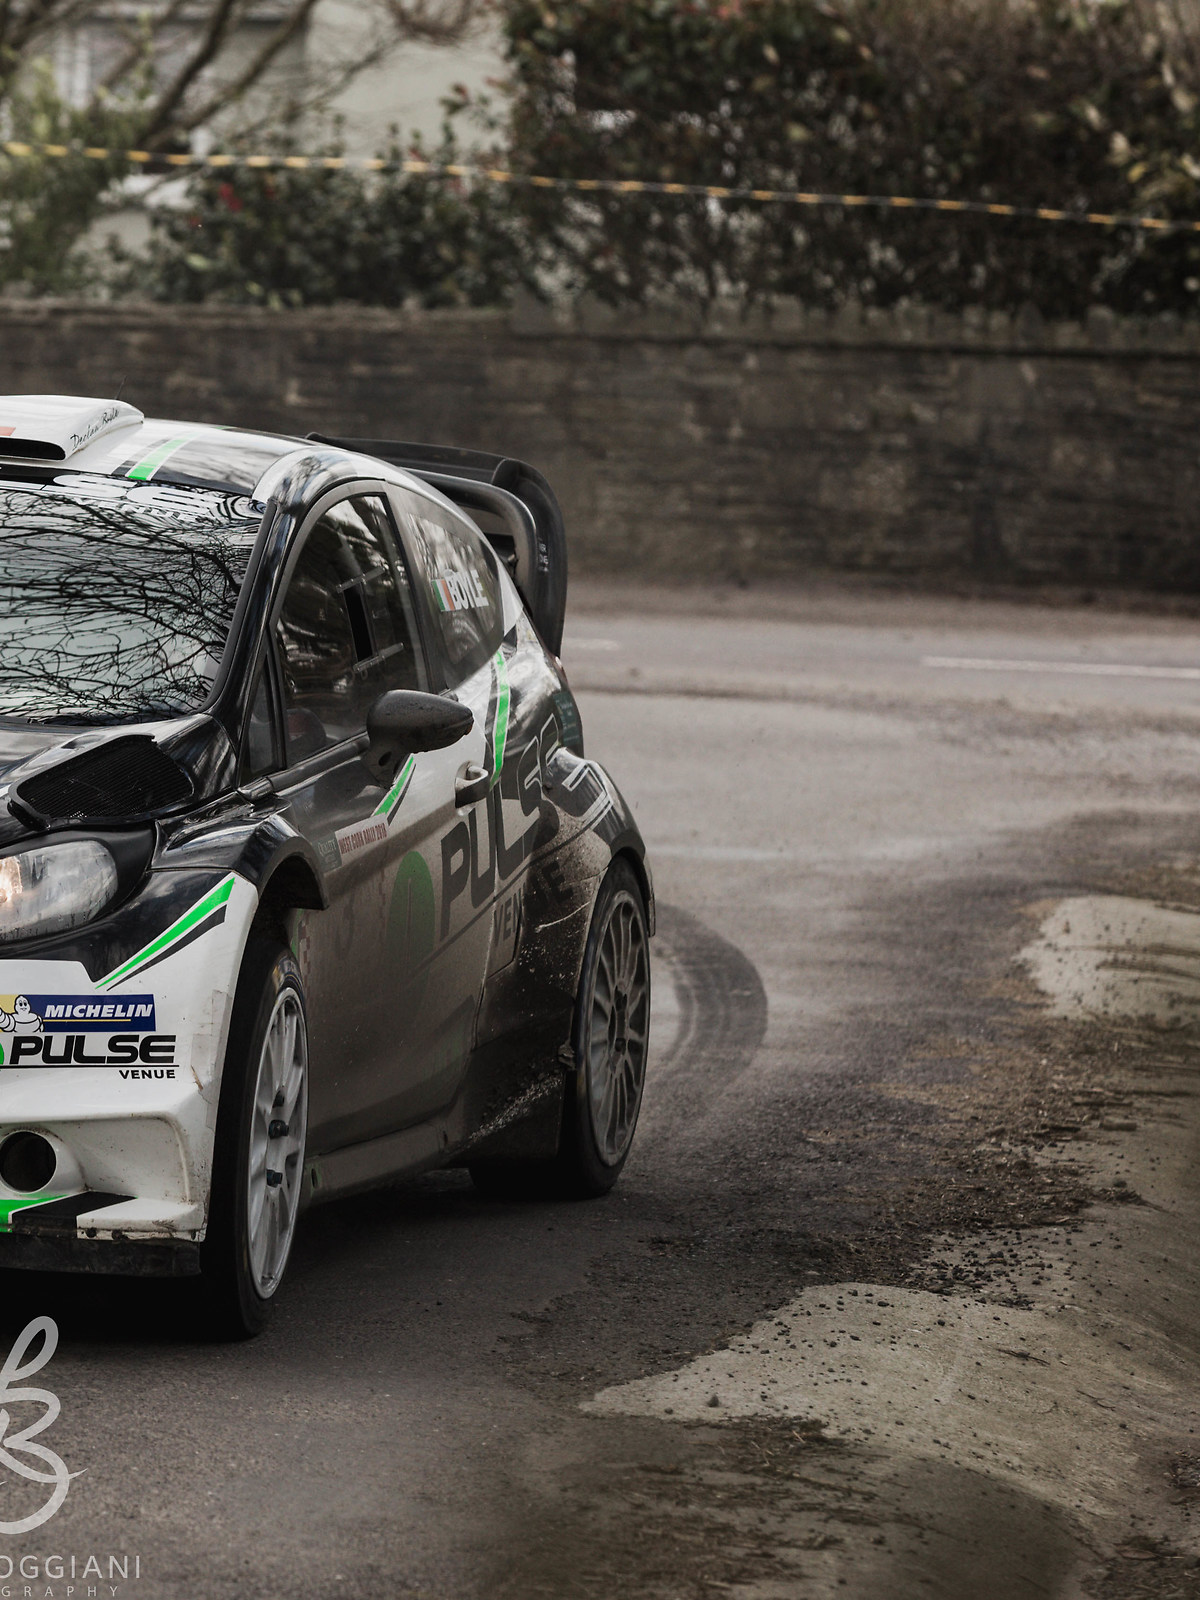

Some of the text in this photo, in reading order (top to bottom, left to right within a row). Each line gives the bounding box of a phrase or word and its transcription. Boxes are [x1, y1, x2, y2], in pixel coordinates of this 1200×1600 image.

[444, 569, 490, 610] BOYLE
[338, 835, 353, 855] WEST
[350, 831, 365, 850] CORK
[45, 1003, 154, 1018] MICHELIN
[9, 1034, 177, 1065] PULSE
[118, 1069, 177, 1080] VENUE
